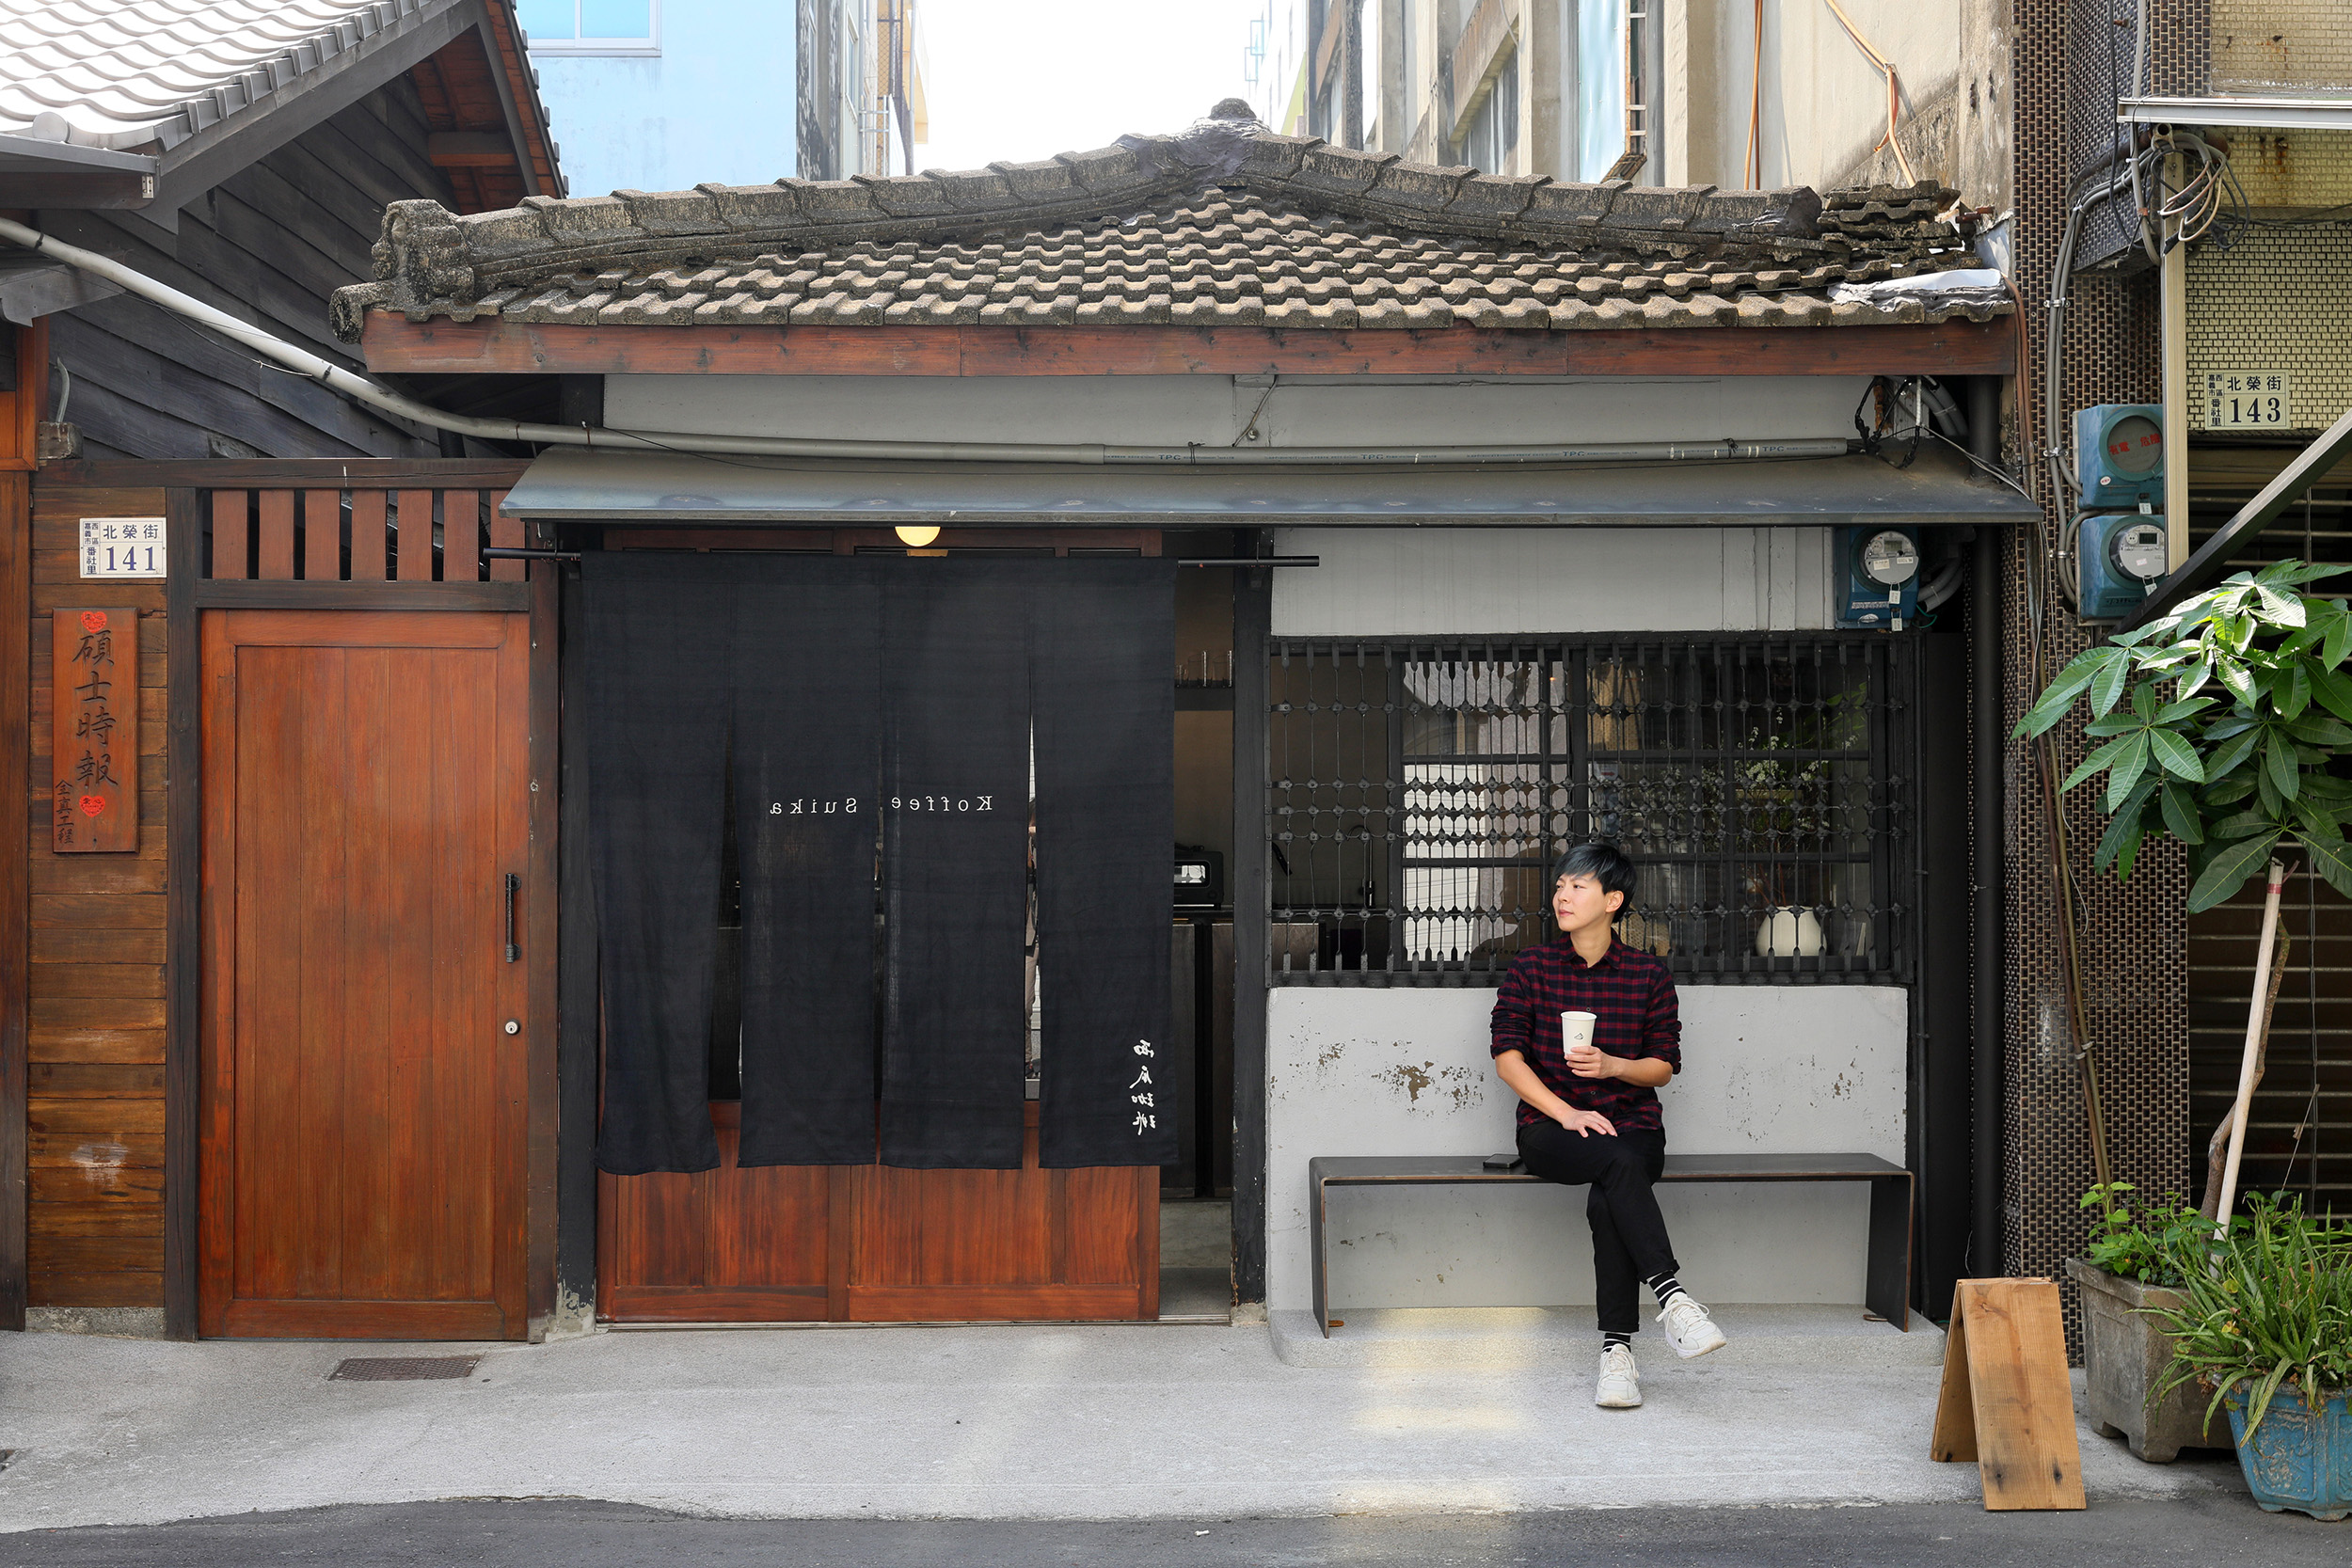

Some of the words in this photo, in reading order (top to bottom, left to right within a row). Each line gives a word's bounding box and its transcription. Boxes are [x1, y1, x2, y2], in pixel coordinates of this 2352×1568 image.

[2227, 375, 2281, 391] 北榮街
[2211, 398, 2222, 426] 番社里
[2231, 397, 2281, 423] 143
[2108, 441, 2130, 456] 有電
[103, 524, 159, 540] 北榮街
[86, 547, 98, 575] 番社里
[105, 546, 156, 571] 141
[72, 629, 118, 788] 碩士時報
[55, 779, 74, 845] 全真工程
